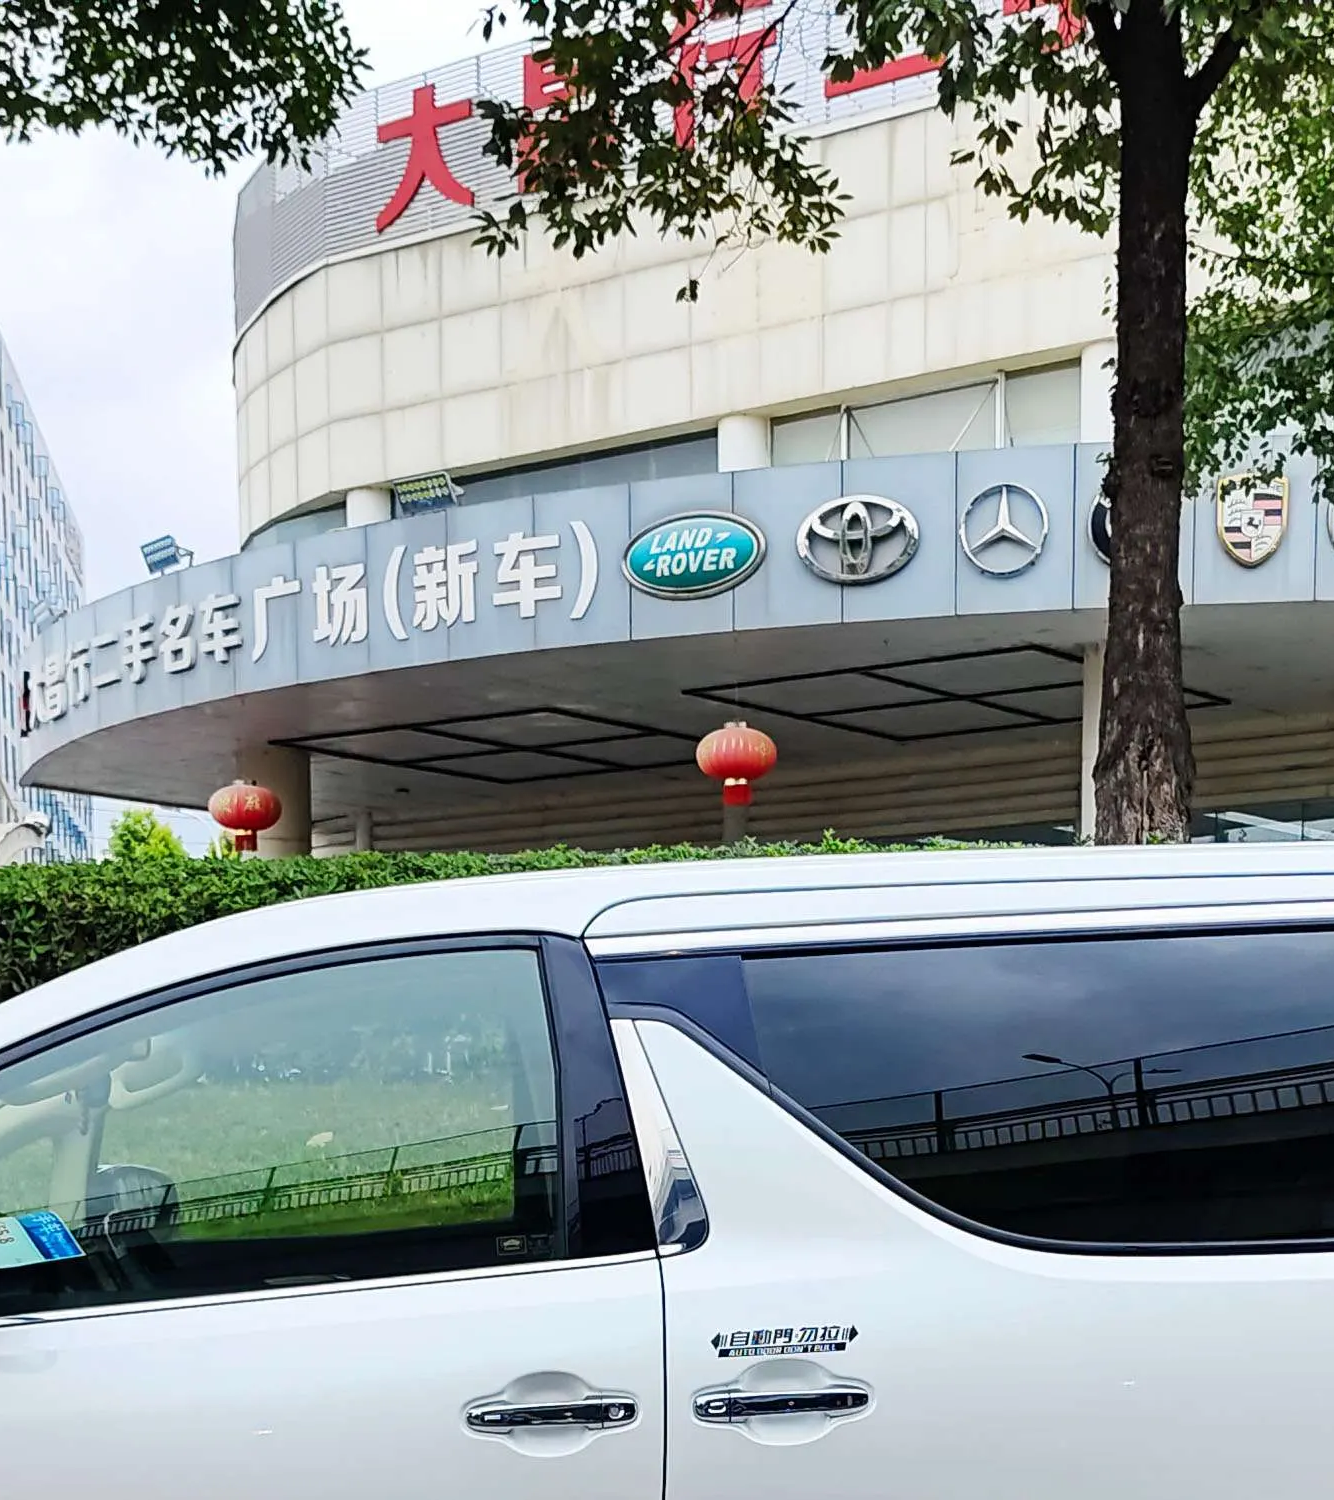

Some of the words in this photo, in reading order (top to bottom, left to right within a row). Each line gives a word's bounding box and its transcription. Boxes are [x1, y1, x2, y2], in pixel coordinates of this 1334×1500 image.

[649, 527, 714, 555] LAND
[655, 547, 738, 577] ROVER
[728, 1347, 756, 1357] AUTO
